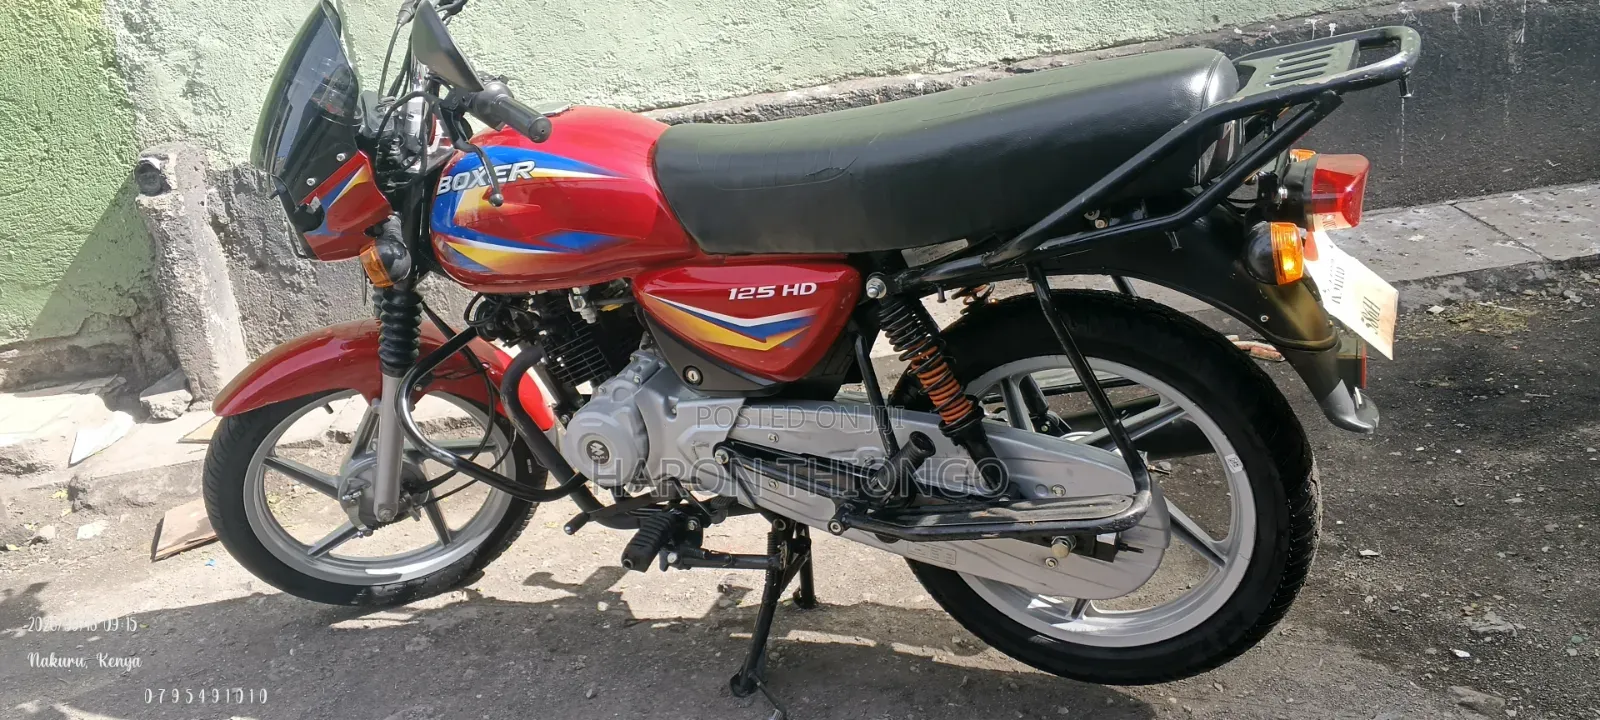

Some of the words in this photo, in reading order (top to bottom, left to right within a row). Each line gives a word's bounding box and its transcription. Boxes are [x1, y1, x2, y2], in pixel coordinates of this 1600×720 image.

[437, 160, 535, 196] BOXER
[728, 285, 777, 301] 125
[782, 282, 818, 297] HD
